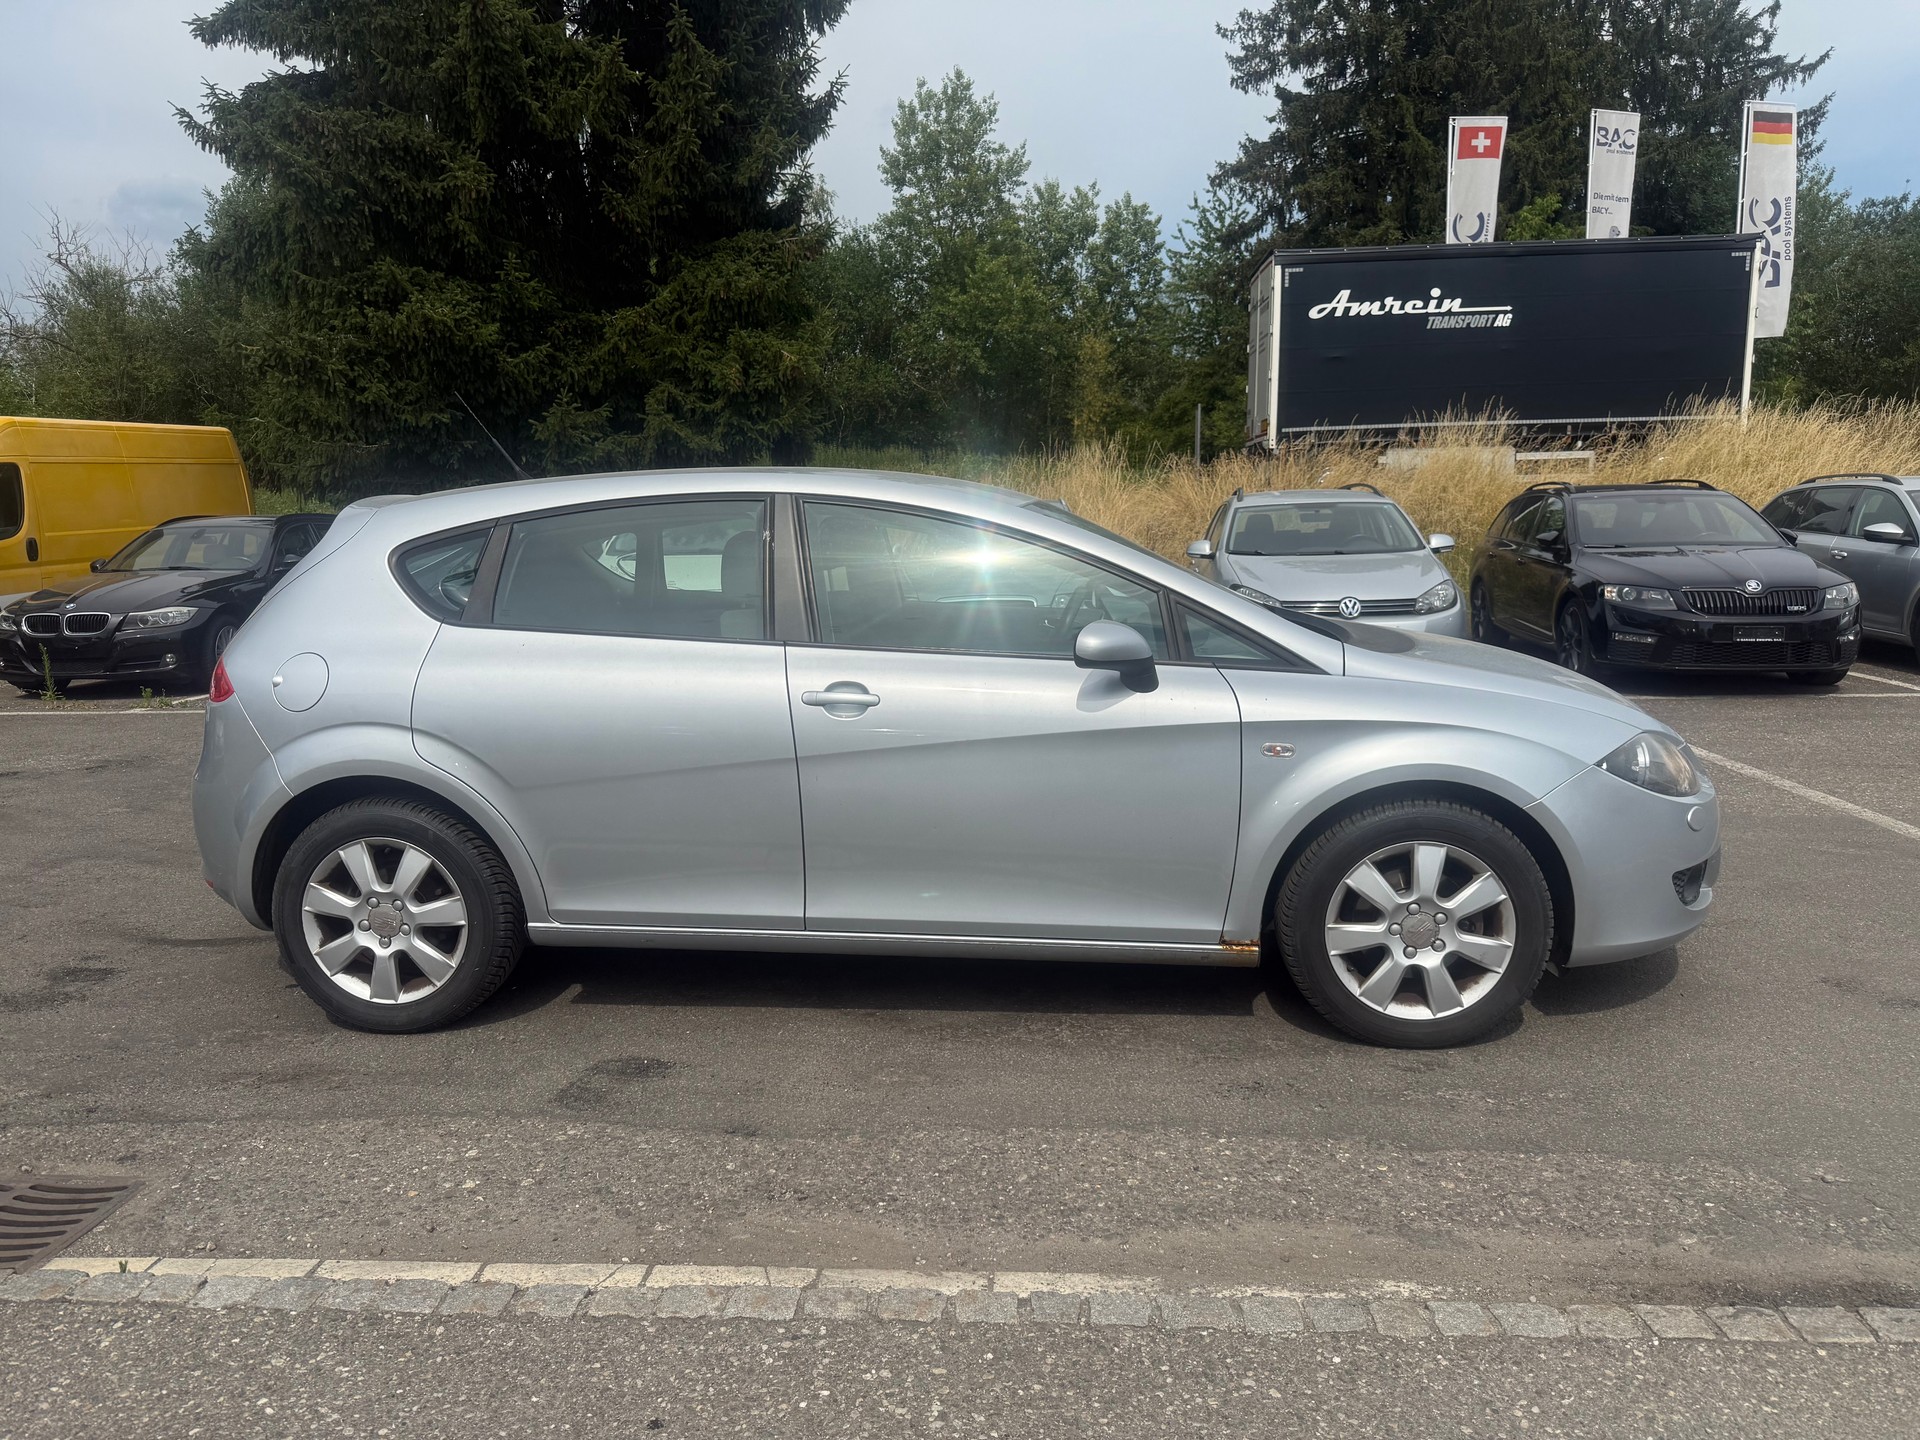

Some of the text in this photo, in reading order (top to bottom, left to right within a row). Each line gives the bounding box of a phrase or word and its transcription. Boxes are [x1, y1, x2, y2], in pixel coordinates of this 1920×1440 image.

[1596, 126, 1636, 150] BAC
[1783, 196, 1793, 261] pool systems
[1308, 287, 1464, 320] Amrein
[1426, 313, 1513, 330] TRANSPORT AG
